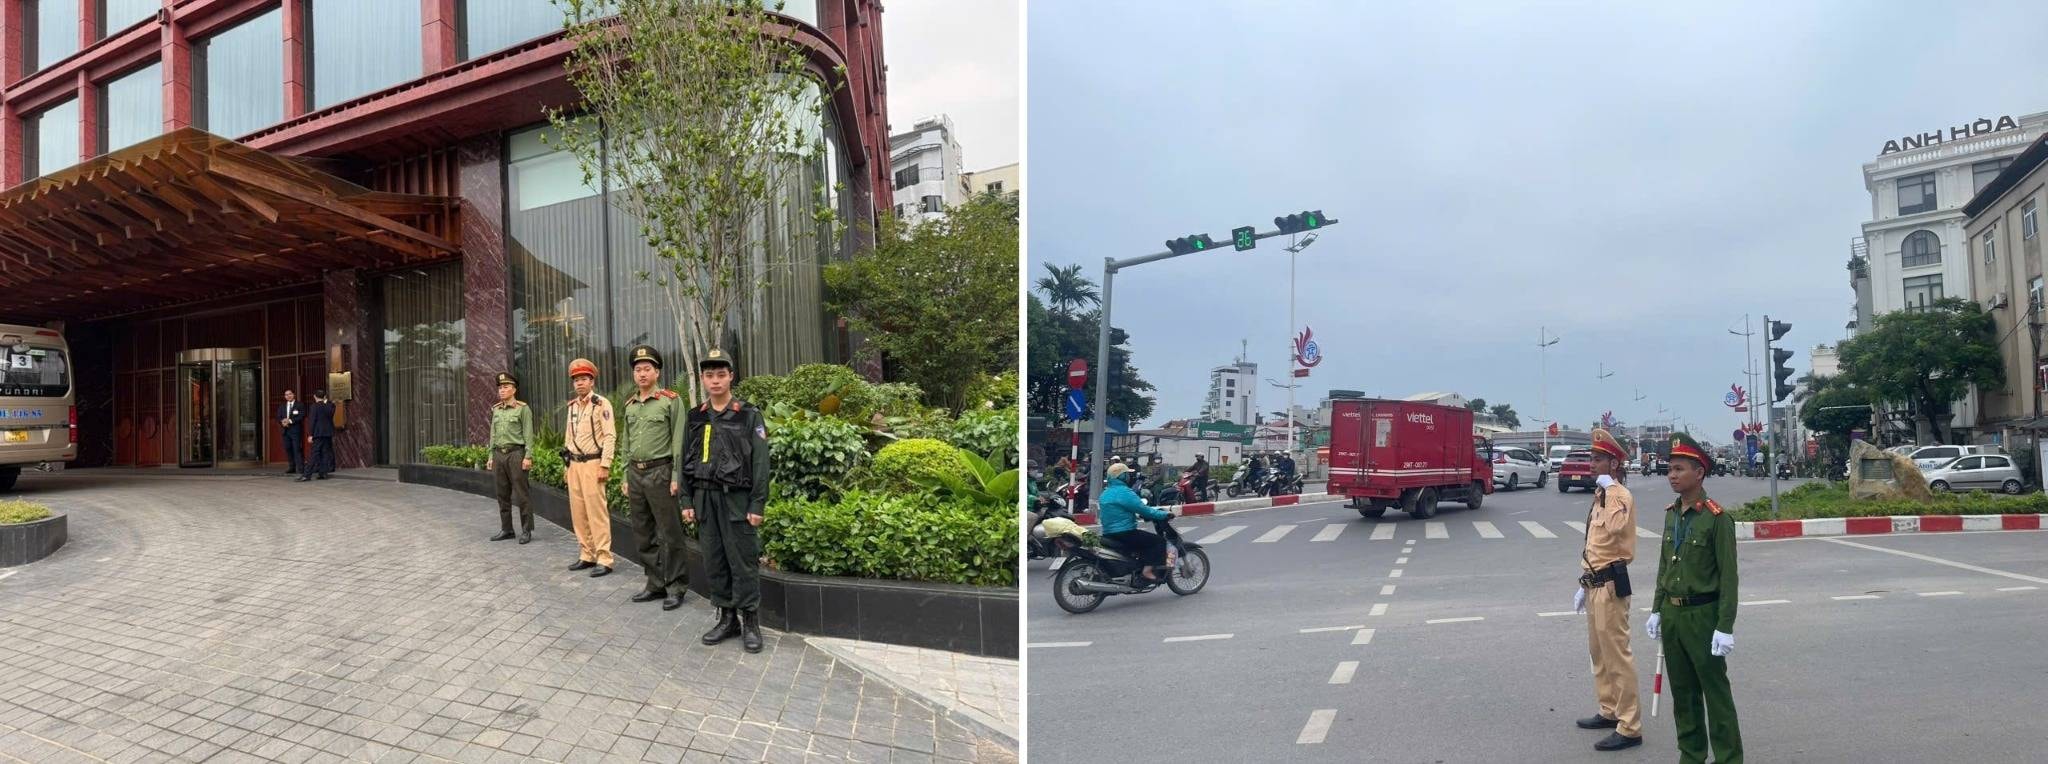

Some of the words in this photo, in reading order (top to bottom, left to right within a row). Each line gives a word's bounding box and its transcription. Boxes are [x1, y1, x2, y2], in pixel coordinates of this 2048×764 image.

[1881, 129, 1943, 155] ANH
[1950, 115, 2017, 141] HÒA
[18, 356, 27, 367] 3
[1406, 411, 1434, 424] viettel
